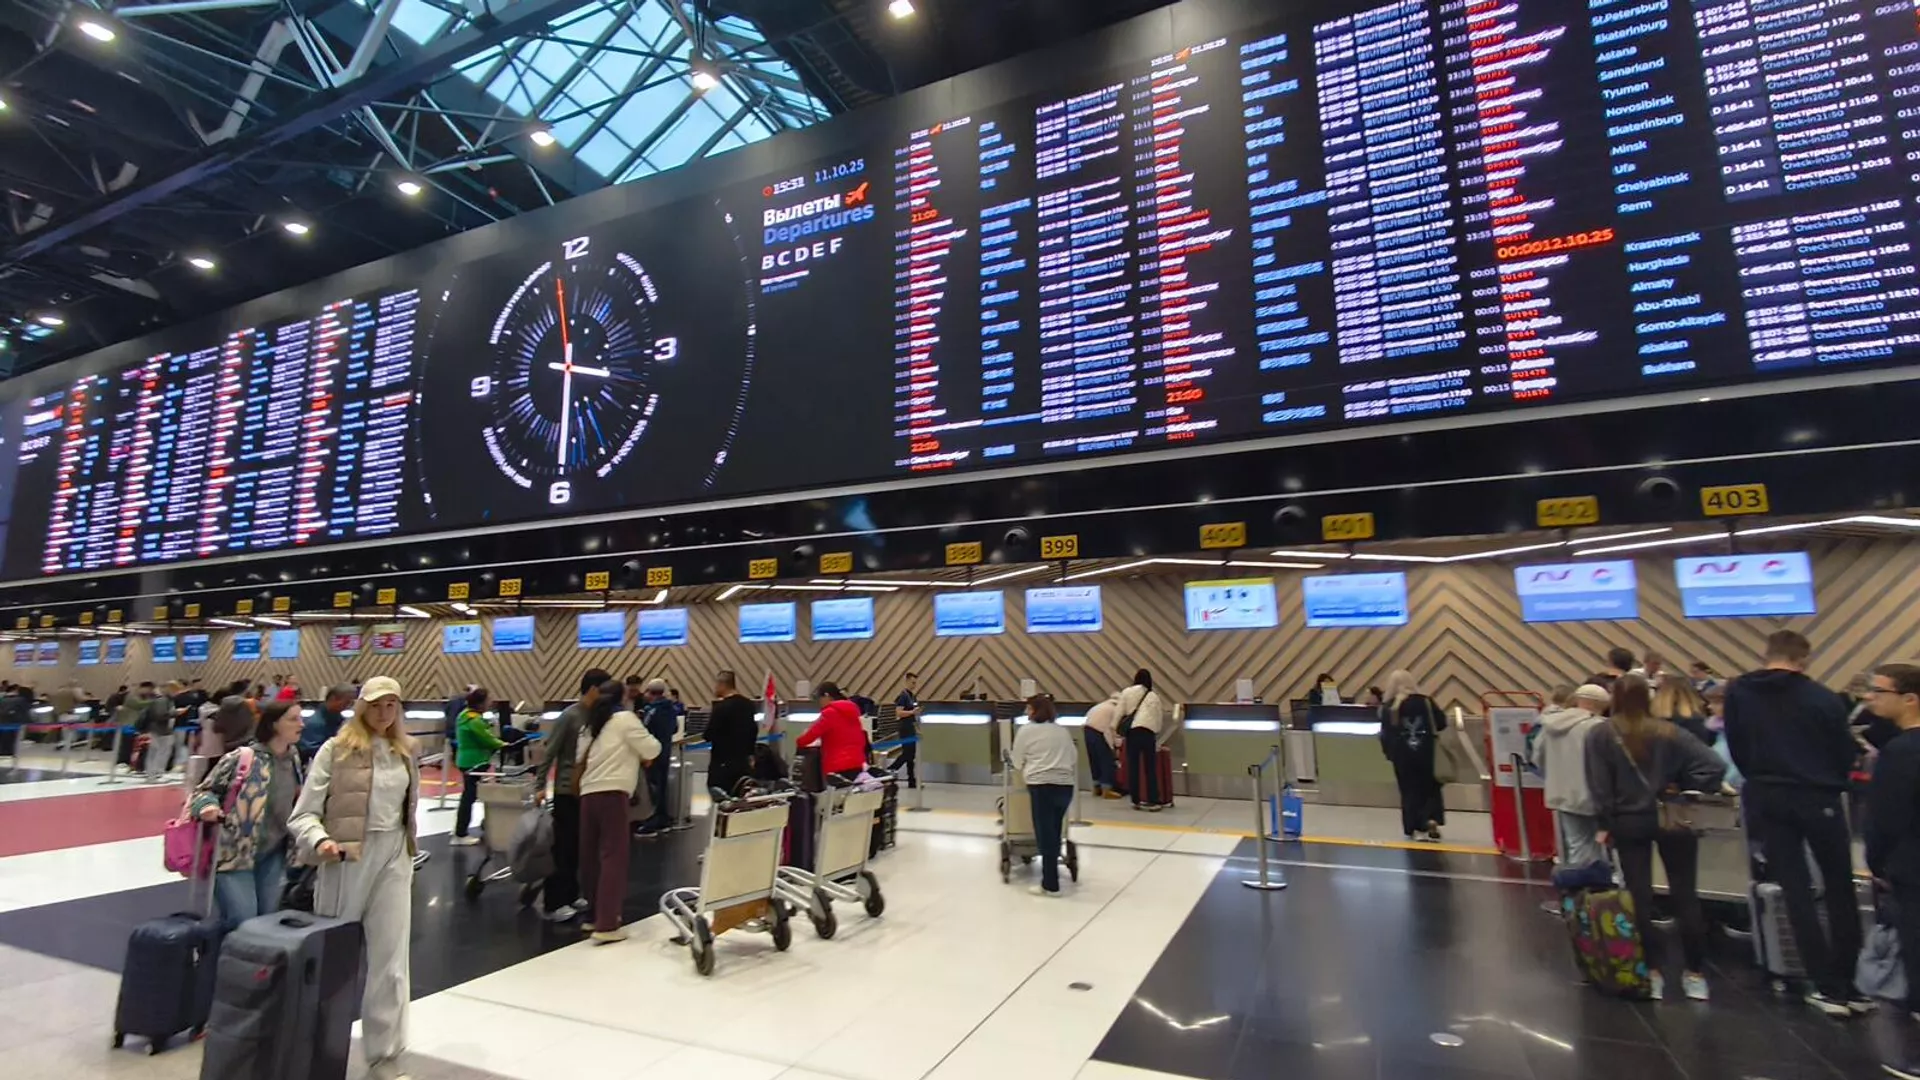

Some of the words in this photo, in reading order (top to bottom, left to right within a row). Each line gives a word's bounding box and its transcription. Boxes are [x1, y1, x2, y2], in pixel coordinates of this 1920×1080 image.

[1592, 0, 1669, 26] St.Petersburg
[1595, 19, 1668, 44] Ekaterinburg
[1596, 46, 1637, 63] Astana
[1884, 42, 1918, 56] 01:00
[1599, 57, 1664, 81] Samarkand
[1450, 86, 1474, 99] 23:40
[1603, 82, 1650, 100] Tyumen
[1720, 80, 1750, 94] 16-41
[1452, 104, 1476, 116] 23:40
[1606, 95, 1675, 118] Novosibirsk
[1724, 100, 1754, 114] 16-41
[1454, 122, 1478, 134] 23:40
[1609, 114, 1684, 137] Ekaterinburg
[1612, 141, 1648, 155] Minsk
[1730, 139, 1762, 153] 16-41
[815, 158, 864, 182] 11.10.25
[1614, 163, 1636, 175] Ufa
[1734, 160, 1766, 172] 16-41
[1616, 172, 1690, 194] Chelyabinsk
[1737, 180, 1770, 193] 16-41
[764, 194, 840, 226] Вылеты
[1619, 200, 1652, 213] Perm
[764, 204, 874, 244] Departures
[562, 236, 589, 259] 12
[1625, 232, 1701, 252] Krasnoyarsk
[762, 255, 774, 270] B
[777, 250, 790, 266] C
[795, 247, 809, 262] D
[812, 242, 824, 258] E
[830, 238, 843, 254] F
[1628, 255, 1690, 273] Hurghada
[1631, 278, 1675, 292] Almaty
[1634, 294, 1702, 313] Abu-Dhabi
[1476, 324, 1504, 335] 00:10
[654, 337, 677, 360] 3
[1479, 344, 1506, 354] 00:10
[471, 376, 491, 398] 9
[550, 482, 570, 504] 6
[1707, 489, 1761, 512] 403
[1541, 500, 1592, 520] 402
[1330, 518, 1365, 534] 401
[1043, 538, 1075, 554] 399
[648, 570, 670, 583] 395
[752, 562, 776, 576] 396
